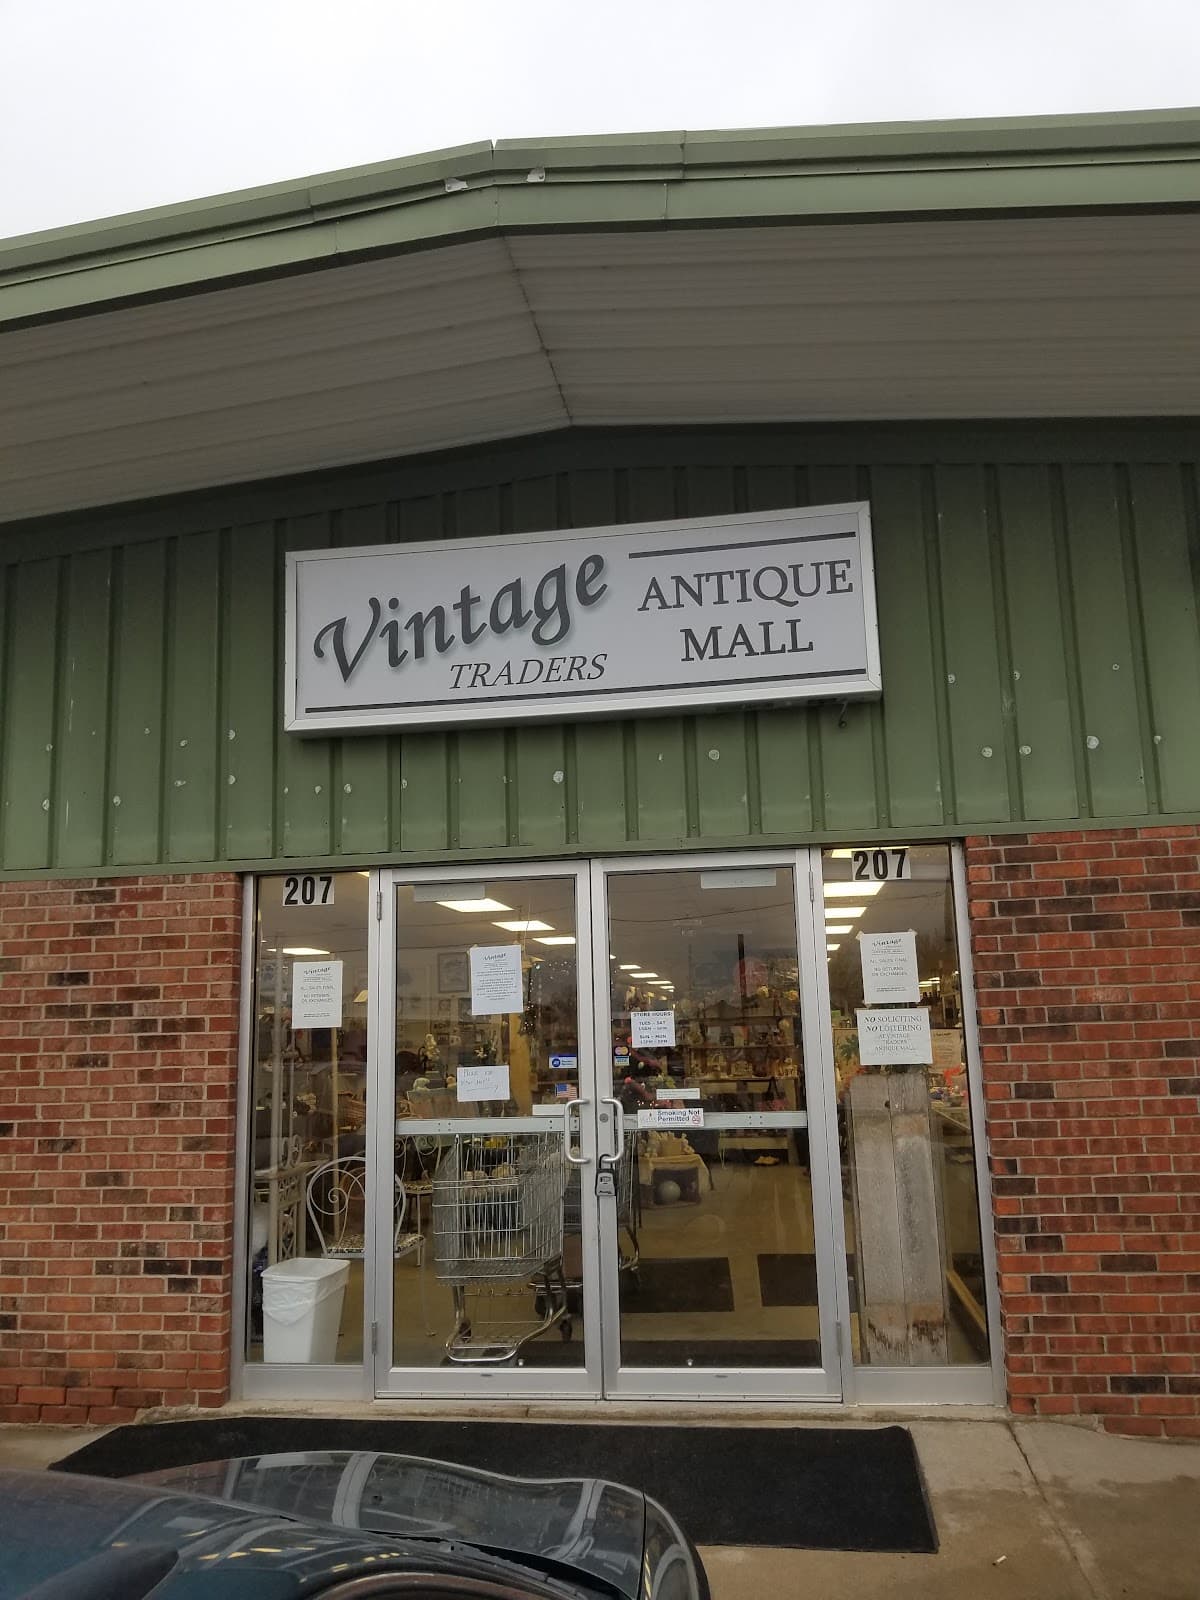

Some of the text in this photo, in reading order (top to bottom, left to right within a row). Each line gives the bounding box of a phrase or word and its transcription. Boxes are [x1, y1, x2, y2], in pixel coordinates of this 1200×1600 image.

[637, 559, 853, 612] ANTIQUE
[313, 554, 608, 683] Vintage
[680, 618, 814, 662] MALL
[449, 653, 608, 690] TRADERS
[852, 849, 906, 880] 207
[284, 876, 333, 905] 207
[877, 1015, 922, 1023] SOLICITING
